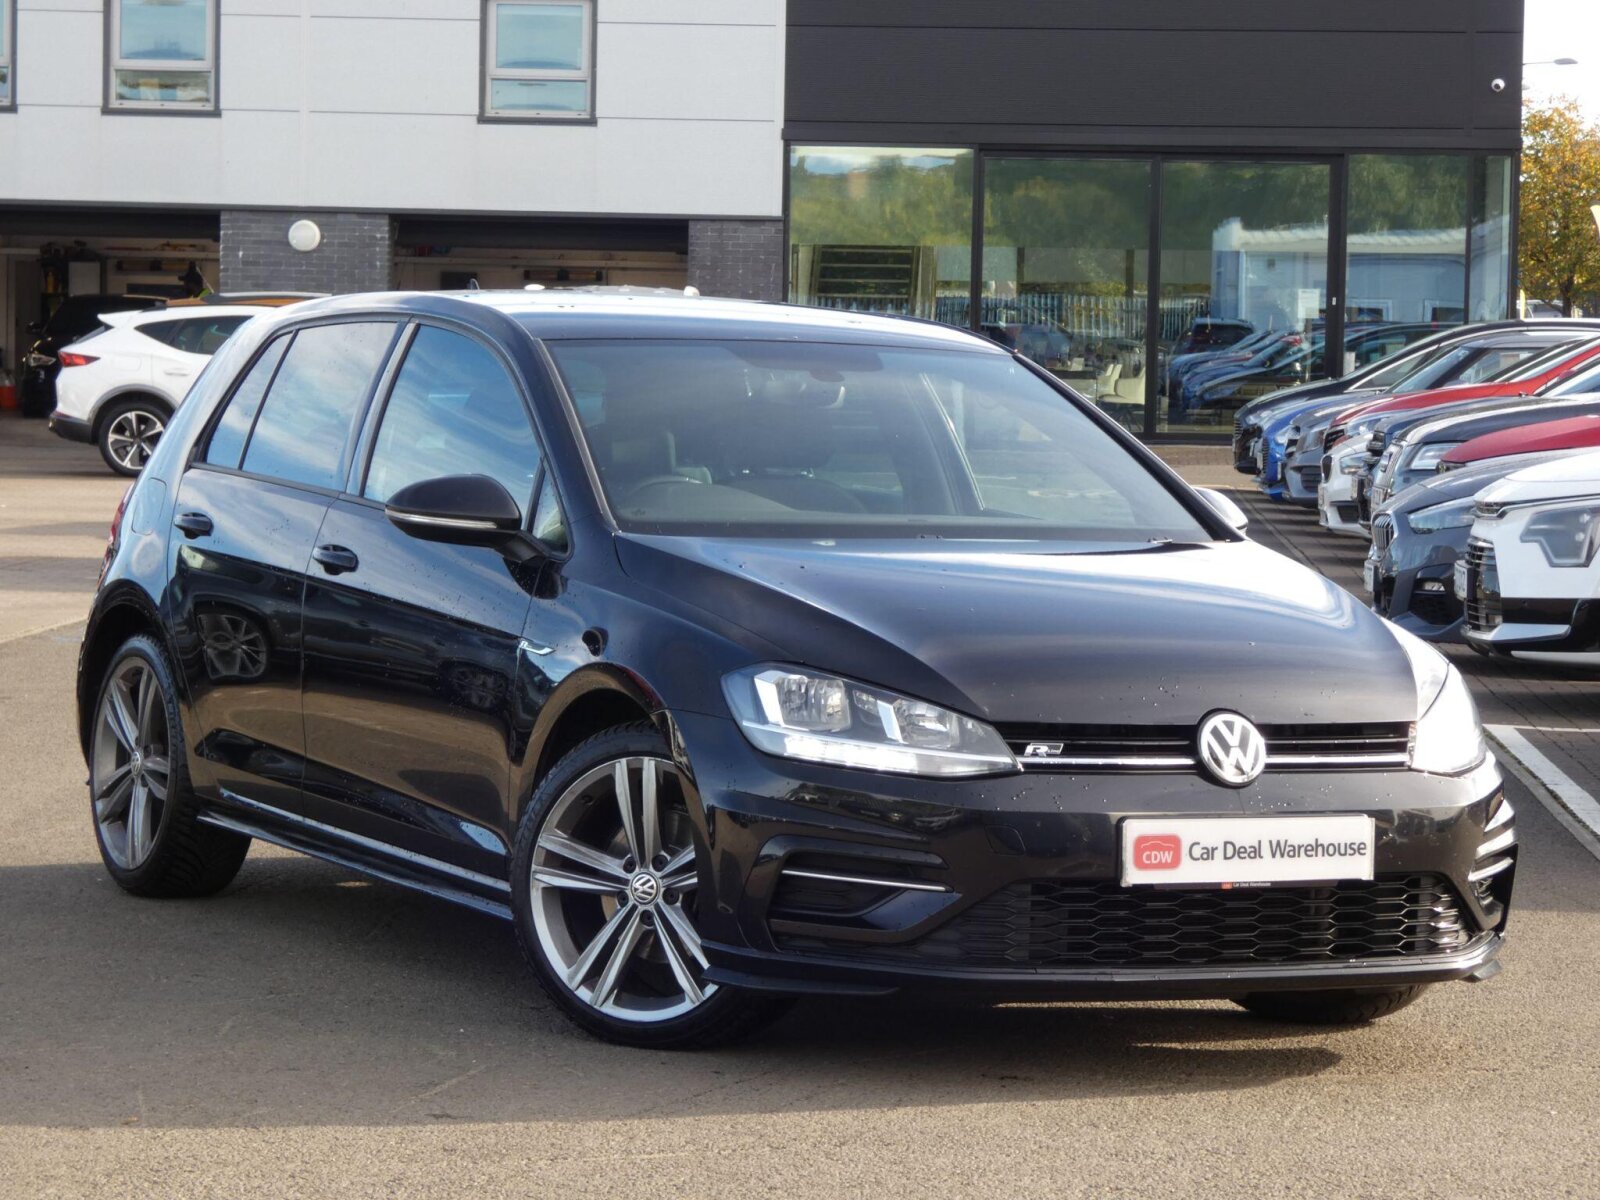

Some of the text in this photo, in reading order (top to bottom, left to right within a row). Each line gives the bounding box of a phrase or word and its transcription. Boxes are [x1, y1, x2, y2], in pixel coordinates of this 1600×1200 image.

[1142, 851, 1174, 864] CDW
[1188, 838, 1367, 861] Car Deal Warehouse
